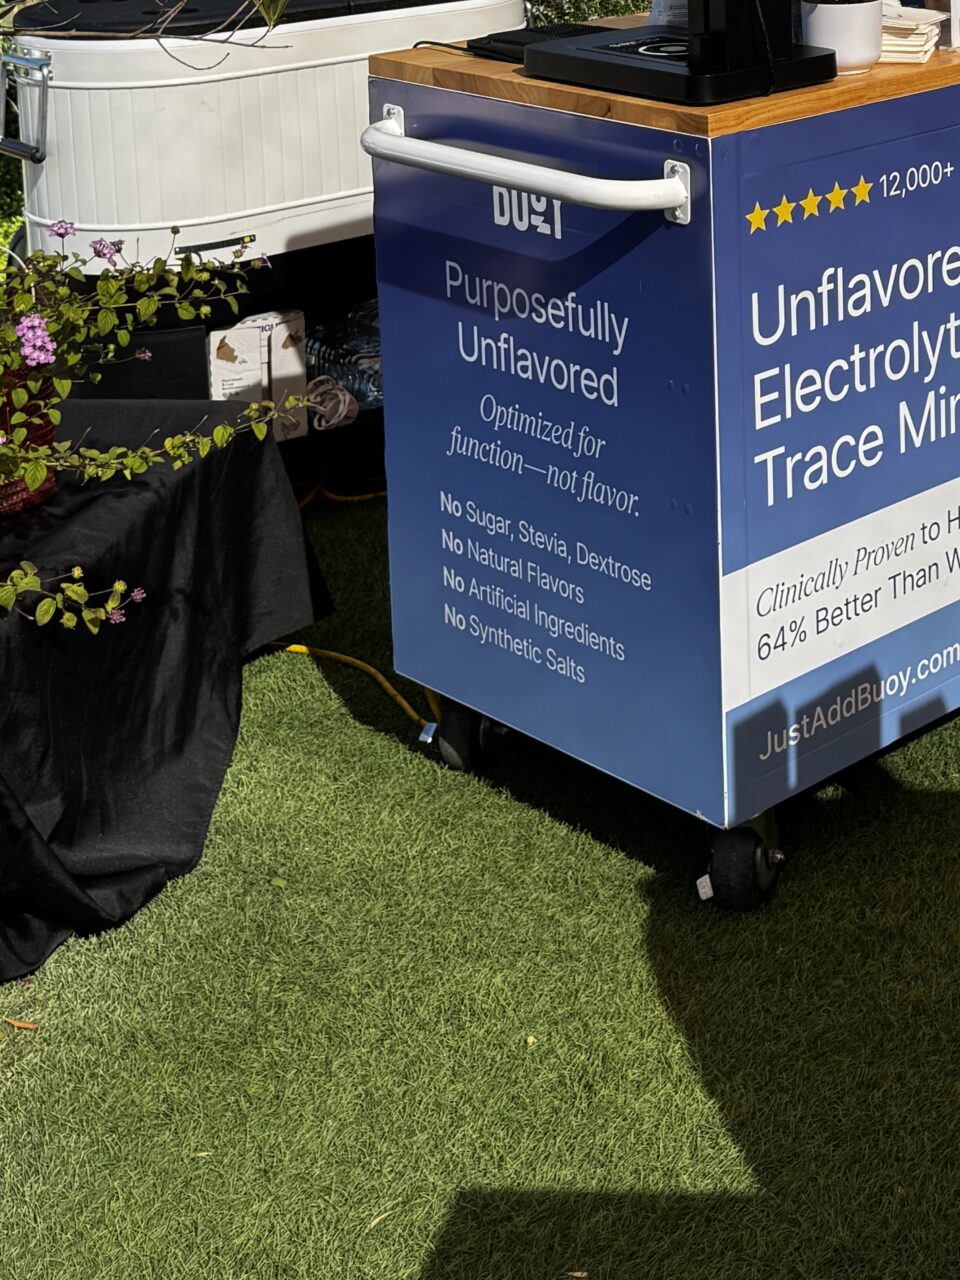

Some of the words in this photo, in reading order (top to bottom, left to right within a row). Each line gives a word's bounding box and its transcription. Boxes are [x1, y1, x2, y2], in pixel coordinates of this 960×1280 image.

[879, 161, 954, 199] 12,000+
[445, 259, 629, 356] Purposefully
[457, 321, 619, 408] Unflavored
[479, 393, 574, 456] Optimized
[572, 424, 606, 460] for
[754, 423, 884, 507] Trace
[578, 472, 641, 517] flavor.
[440, 490, 463, 519] No
[466, 500, 515, 544] Sugar,
[518, 523, 573, 565] Stevia,
[576, 542, 652, 592] Dextrose
[441, 528, 464, 556] No
[467, 537, 523, 581] Natural
[527, 563, 585, 605] Flavors
[756, 556, 849, 618] Clinically
[853, 530, 917, 578] Proven
[920, 521, 941, 546] to
[442, 566, 465, 594] No
[468, 576, 530, 622] Artificial
[534, 603, 626, 662] Ingredients
[444, 602, 467, 632] No
[469, 613, 542, 667] Synthetic
[545, 647, 586, 684] Salts
[757, 615, 808, 661] 64%
[815, 586, 882, 635] Better
[888, 559, 940, 600] Than
